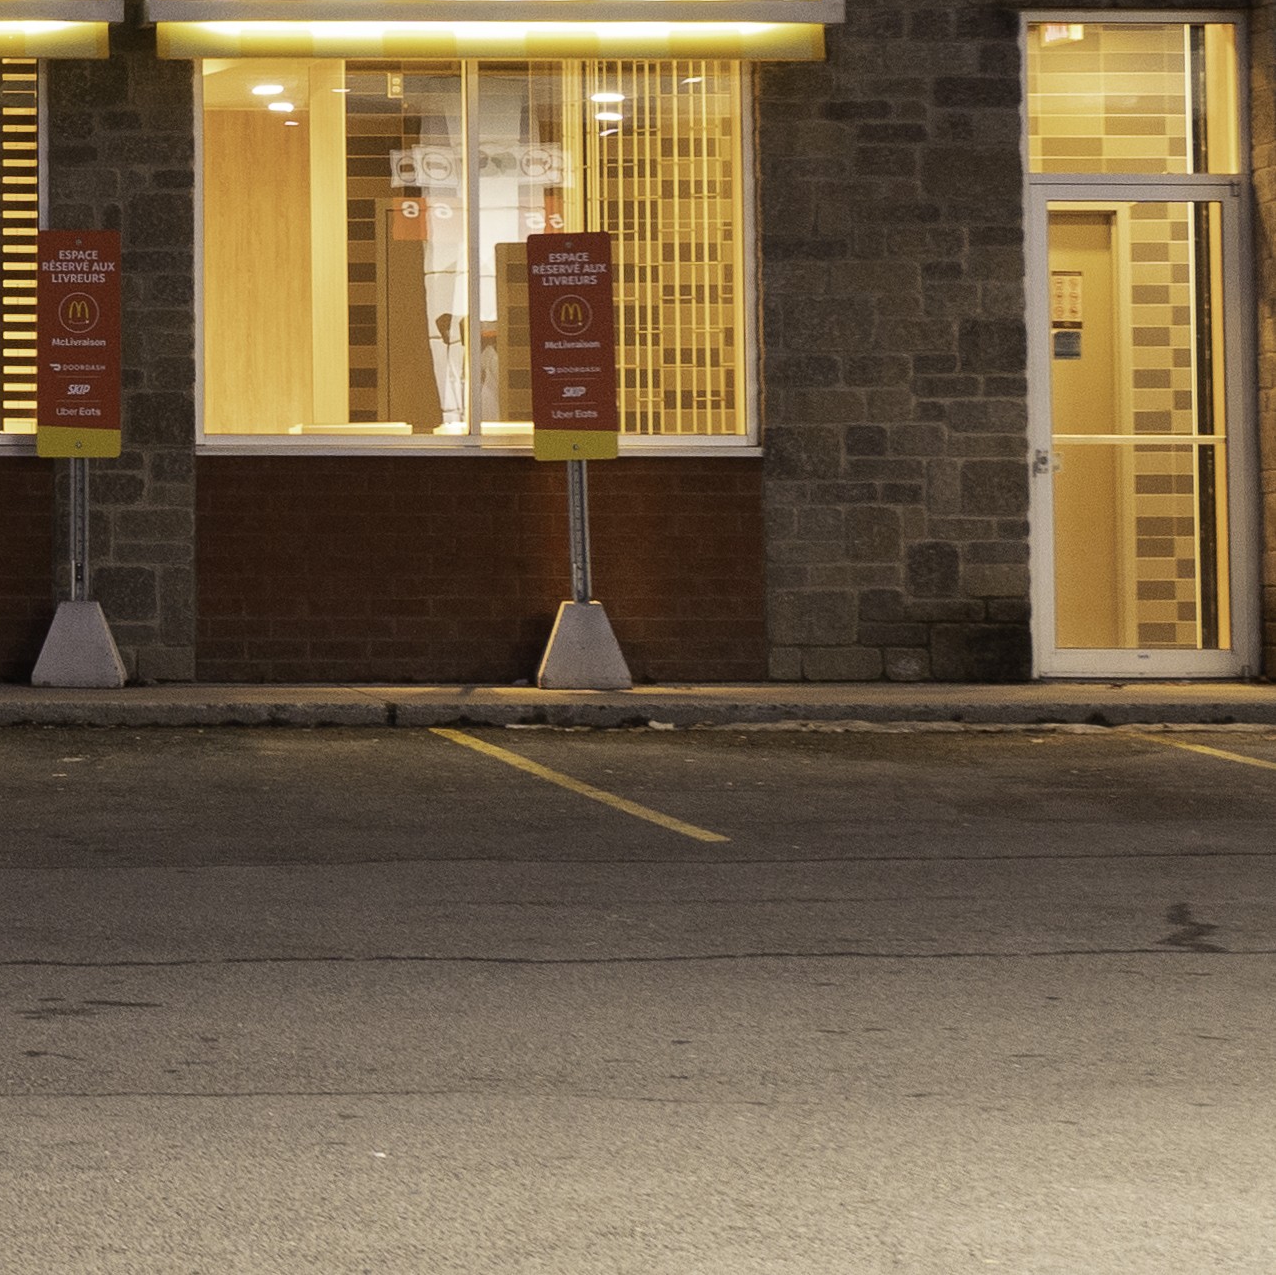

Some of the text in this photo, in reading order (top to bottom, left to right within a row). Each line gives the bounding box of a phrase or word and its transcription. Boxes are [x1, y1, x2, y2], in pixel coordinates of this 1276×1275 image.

[59, 250, 98, 260] ESPACE
[548, 252, 589, 263] ESPACE
[42, 260, 115, 271] RÉSERVÉ AUX
[532, 262, 607, 274] RÉSERVÉ AUX
[51, 273, 106, 283] LIVREURS
[542, 275, 597, 286] LIVREURS
[51, 338, 106, 347] McLivraison
[67, 384, 91, 395] SKIP
[56, 407, 102, 416] Uber Eats
